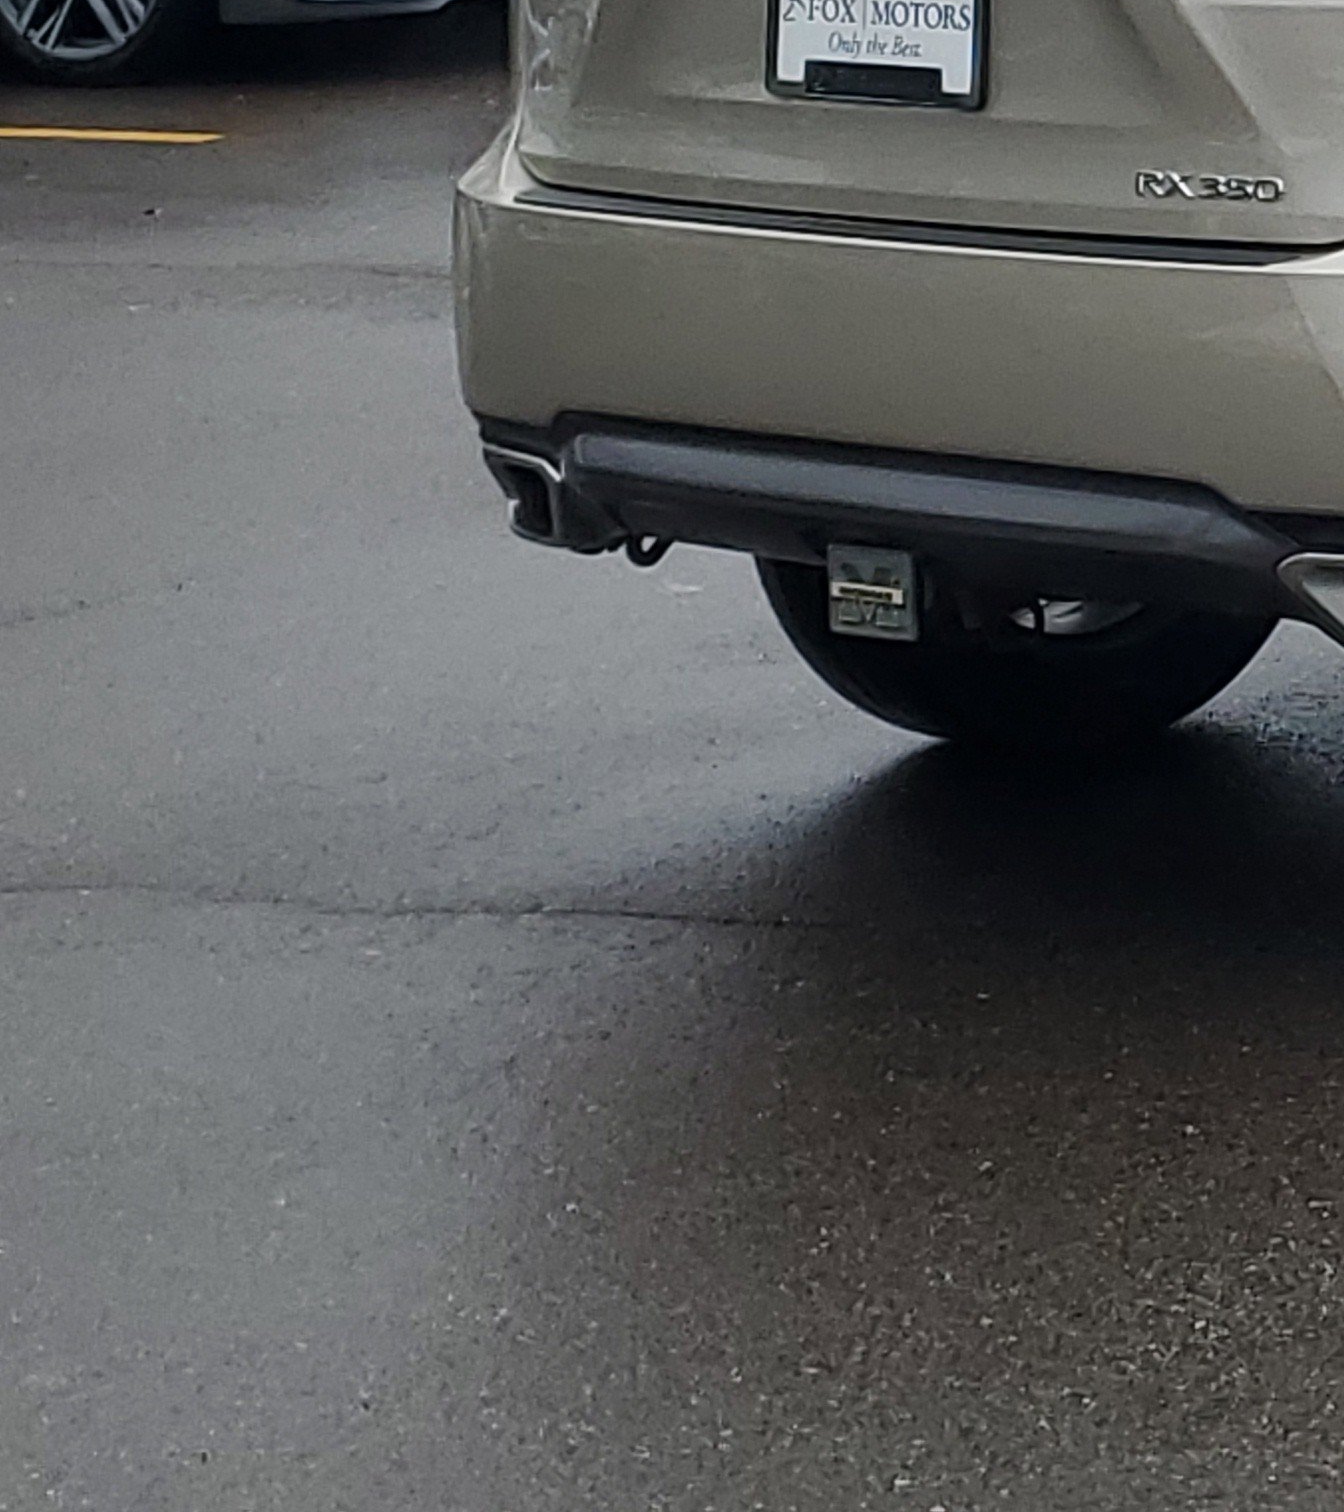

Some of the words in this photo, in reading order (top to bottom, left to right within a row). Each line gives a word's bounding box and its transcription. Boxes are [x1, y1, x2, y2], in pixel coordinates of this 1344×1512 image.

[870, 0, 971, 31] MOTORS
[828, 31, 861, 59] Only
[866, 32, 888, 55] the
[891, 35, 922, 57] Best
